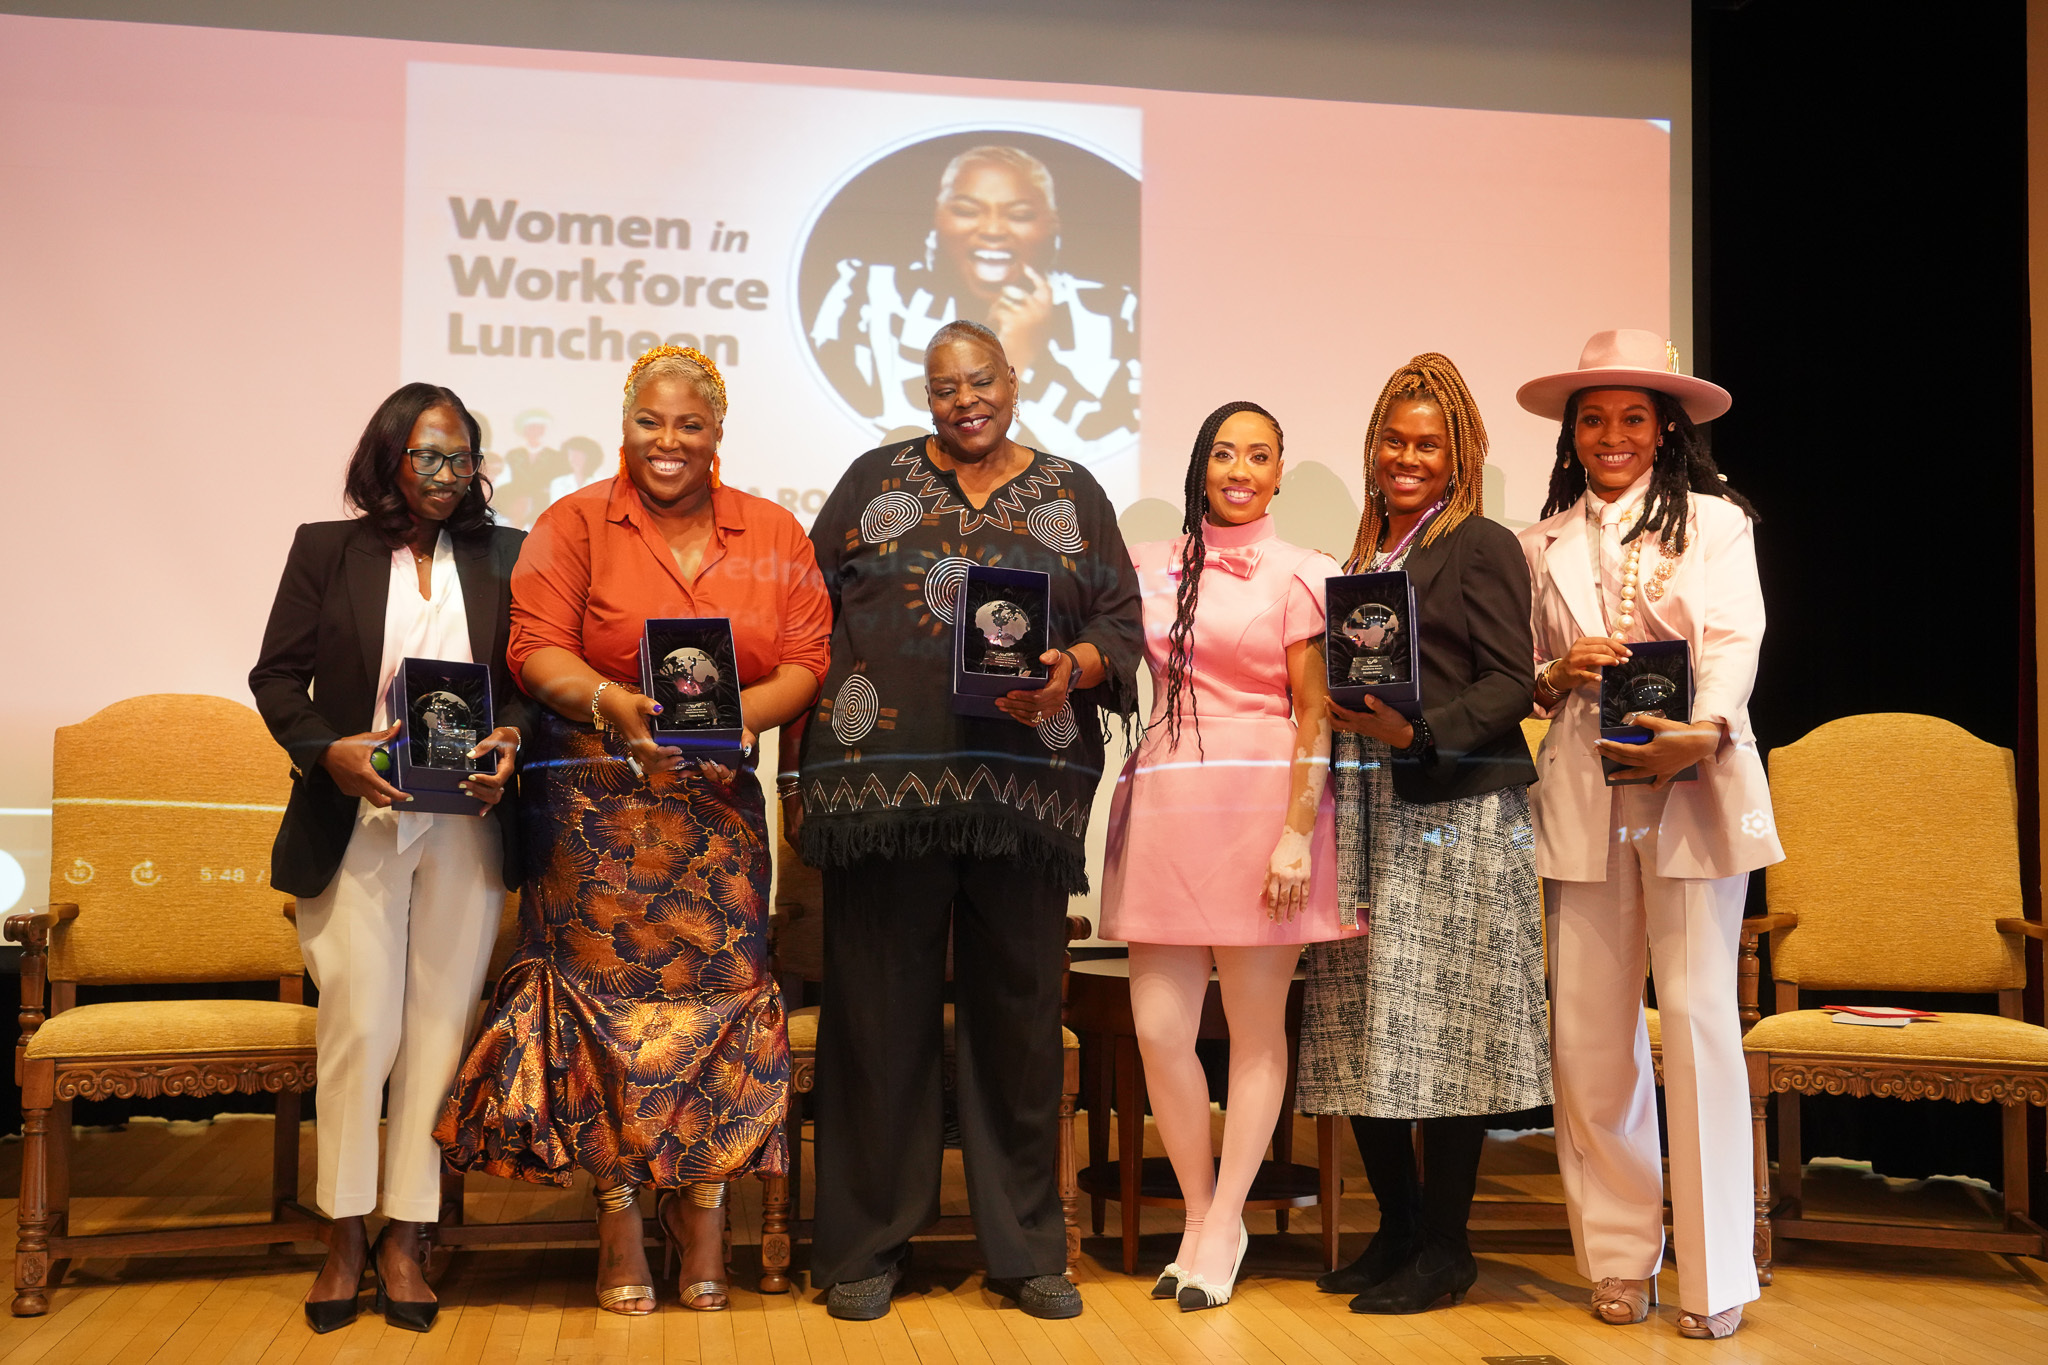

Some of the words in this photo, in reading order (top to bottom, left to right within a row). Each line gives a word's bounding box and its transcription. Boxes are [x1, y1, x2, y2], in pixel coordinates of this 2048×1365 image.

[449, 196, 691, 251] Women
[709, 221, 750, 253] in
[448, 254, 770, 311] Workforce
[200, 867, 245, 882] 5:48
